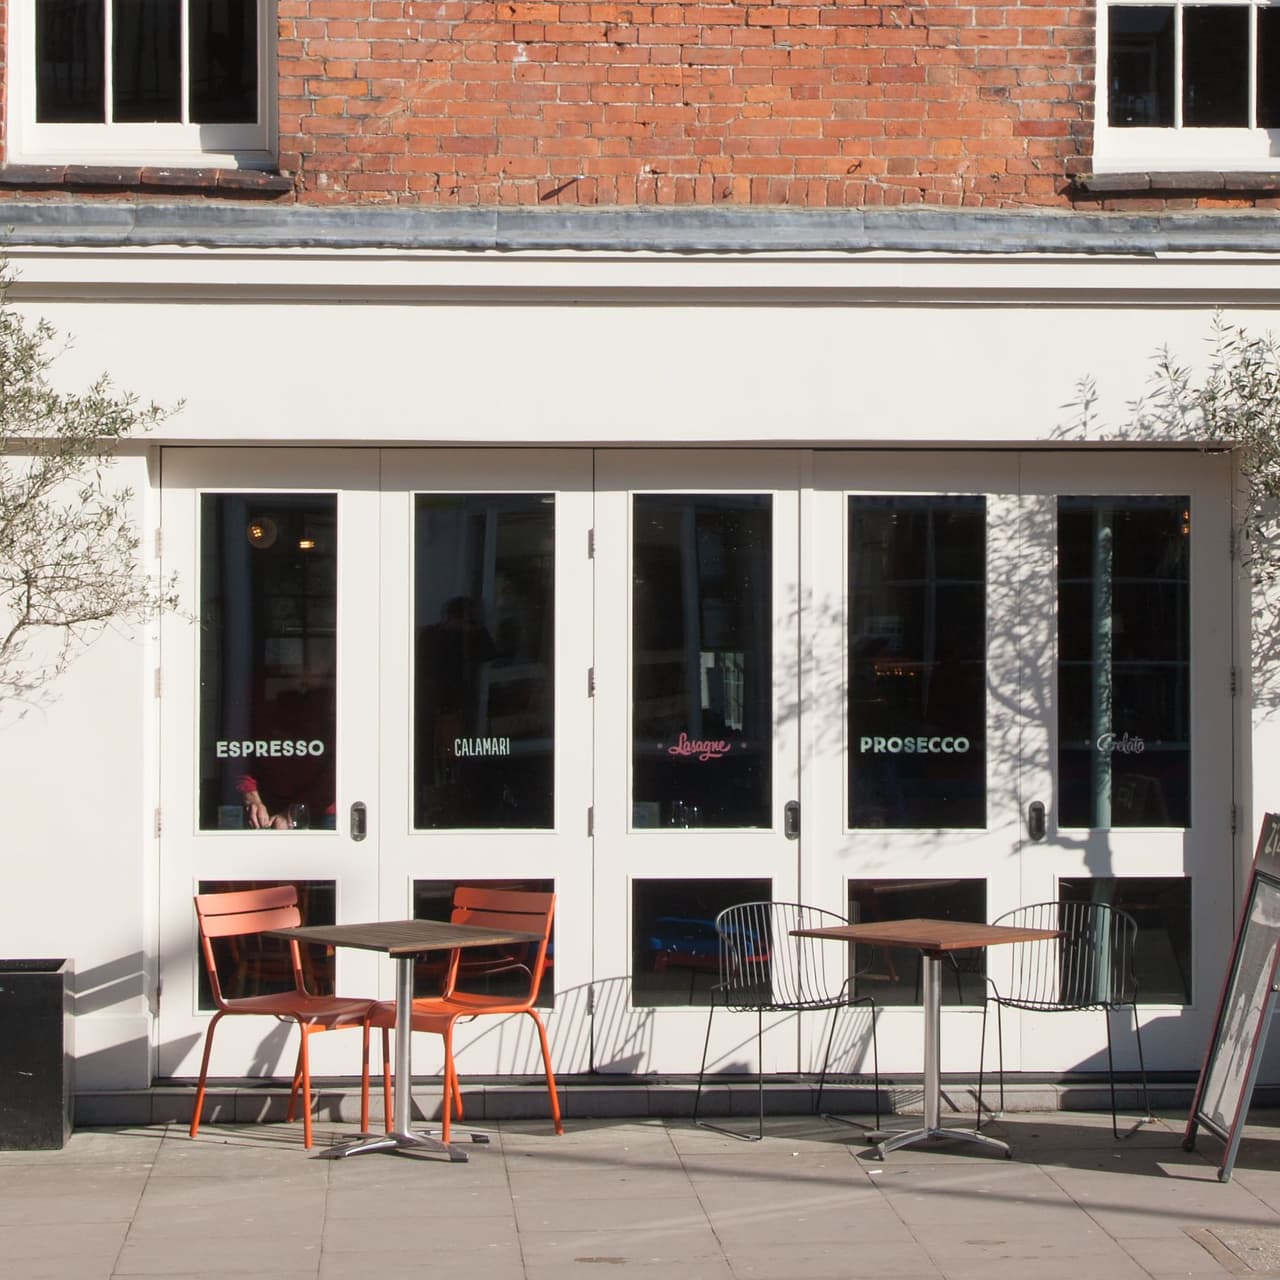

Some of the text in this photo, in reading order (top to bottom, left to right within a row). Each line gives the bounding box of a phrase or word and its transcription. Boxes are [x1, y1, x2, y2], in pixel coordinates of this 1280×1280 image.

[216, 739, 325, 758] ESPRESSO
[454, 737, 510, 757] CALAMARI
[668, 732, 732, 761] Lasagne
[860, 736, 970, 753] PROSECCO
[1096, 731, 1145, 754] Gelato
